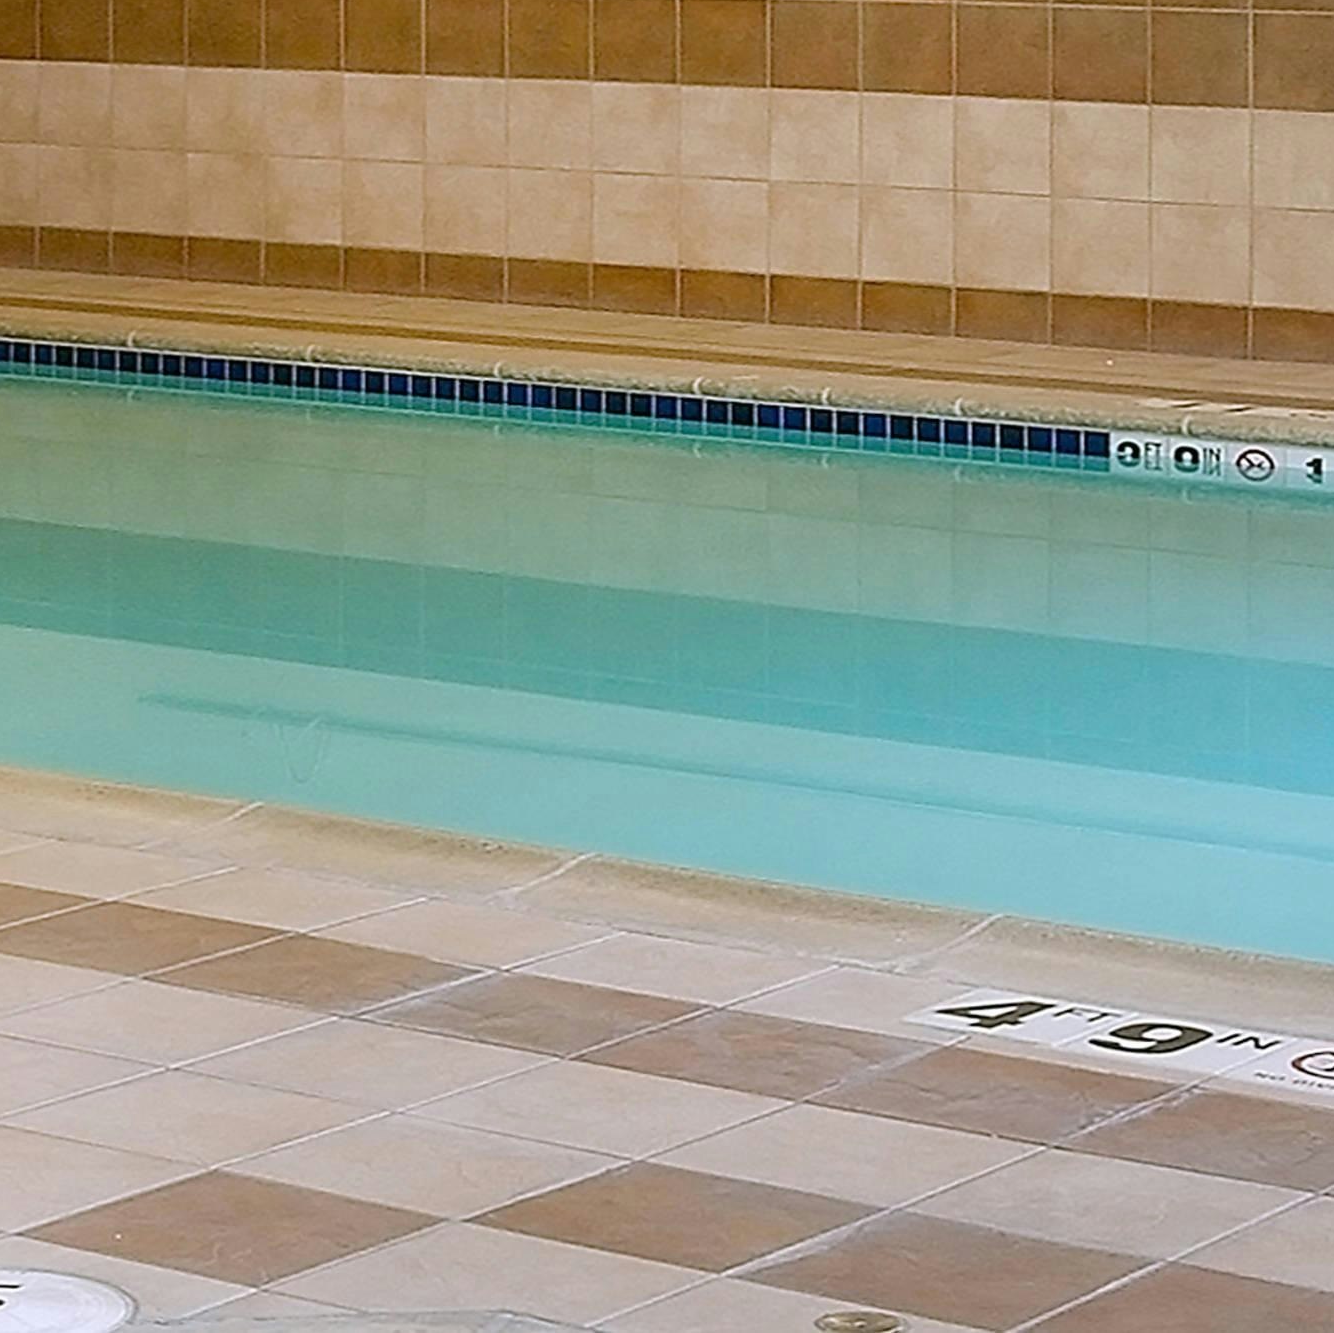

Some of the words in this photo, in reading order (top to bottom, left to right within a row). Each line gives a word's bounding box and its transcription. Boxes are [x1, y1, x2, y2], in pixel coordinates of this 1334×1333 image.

[934, 1001, 1057, 1030] 4
[1051, 1006, 1123, 1023] FT
[1087, 1022, 1214, 1054] 9
[1217, 1033, 1281, 1050] IN
